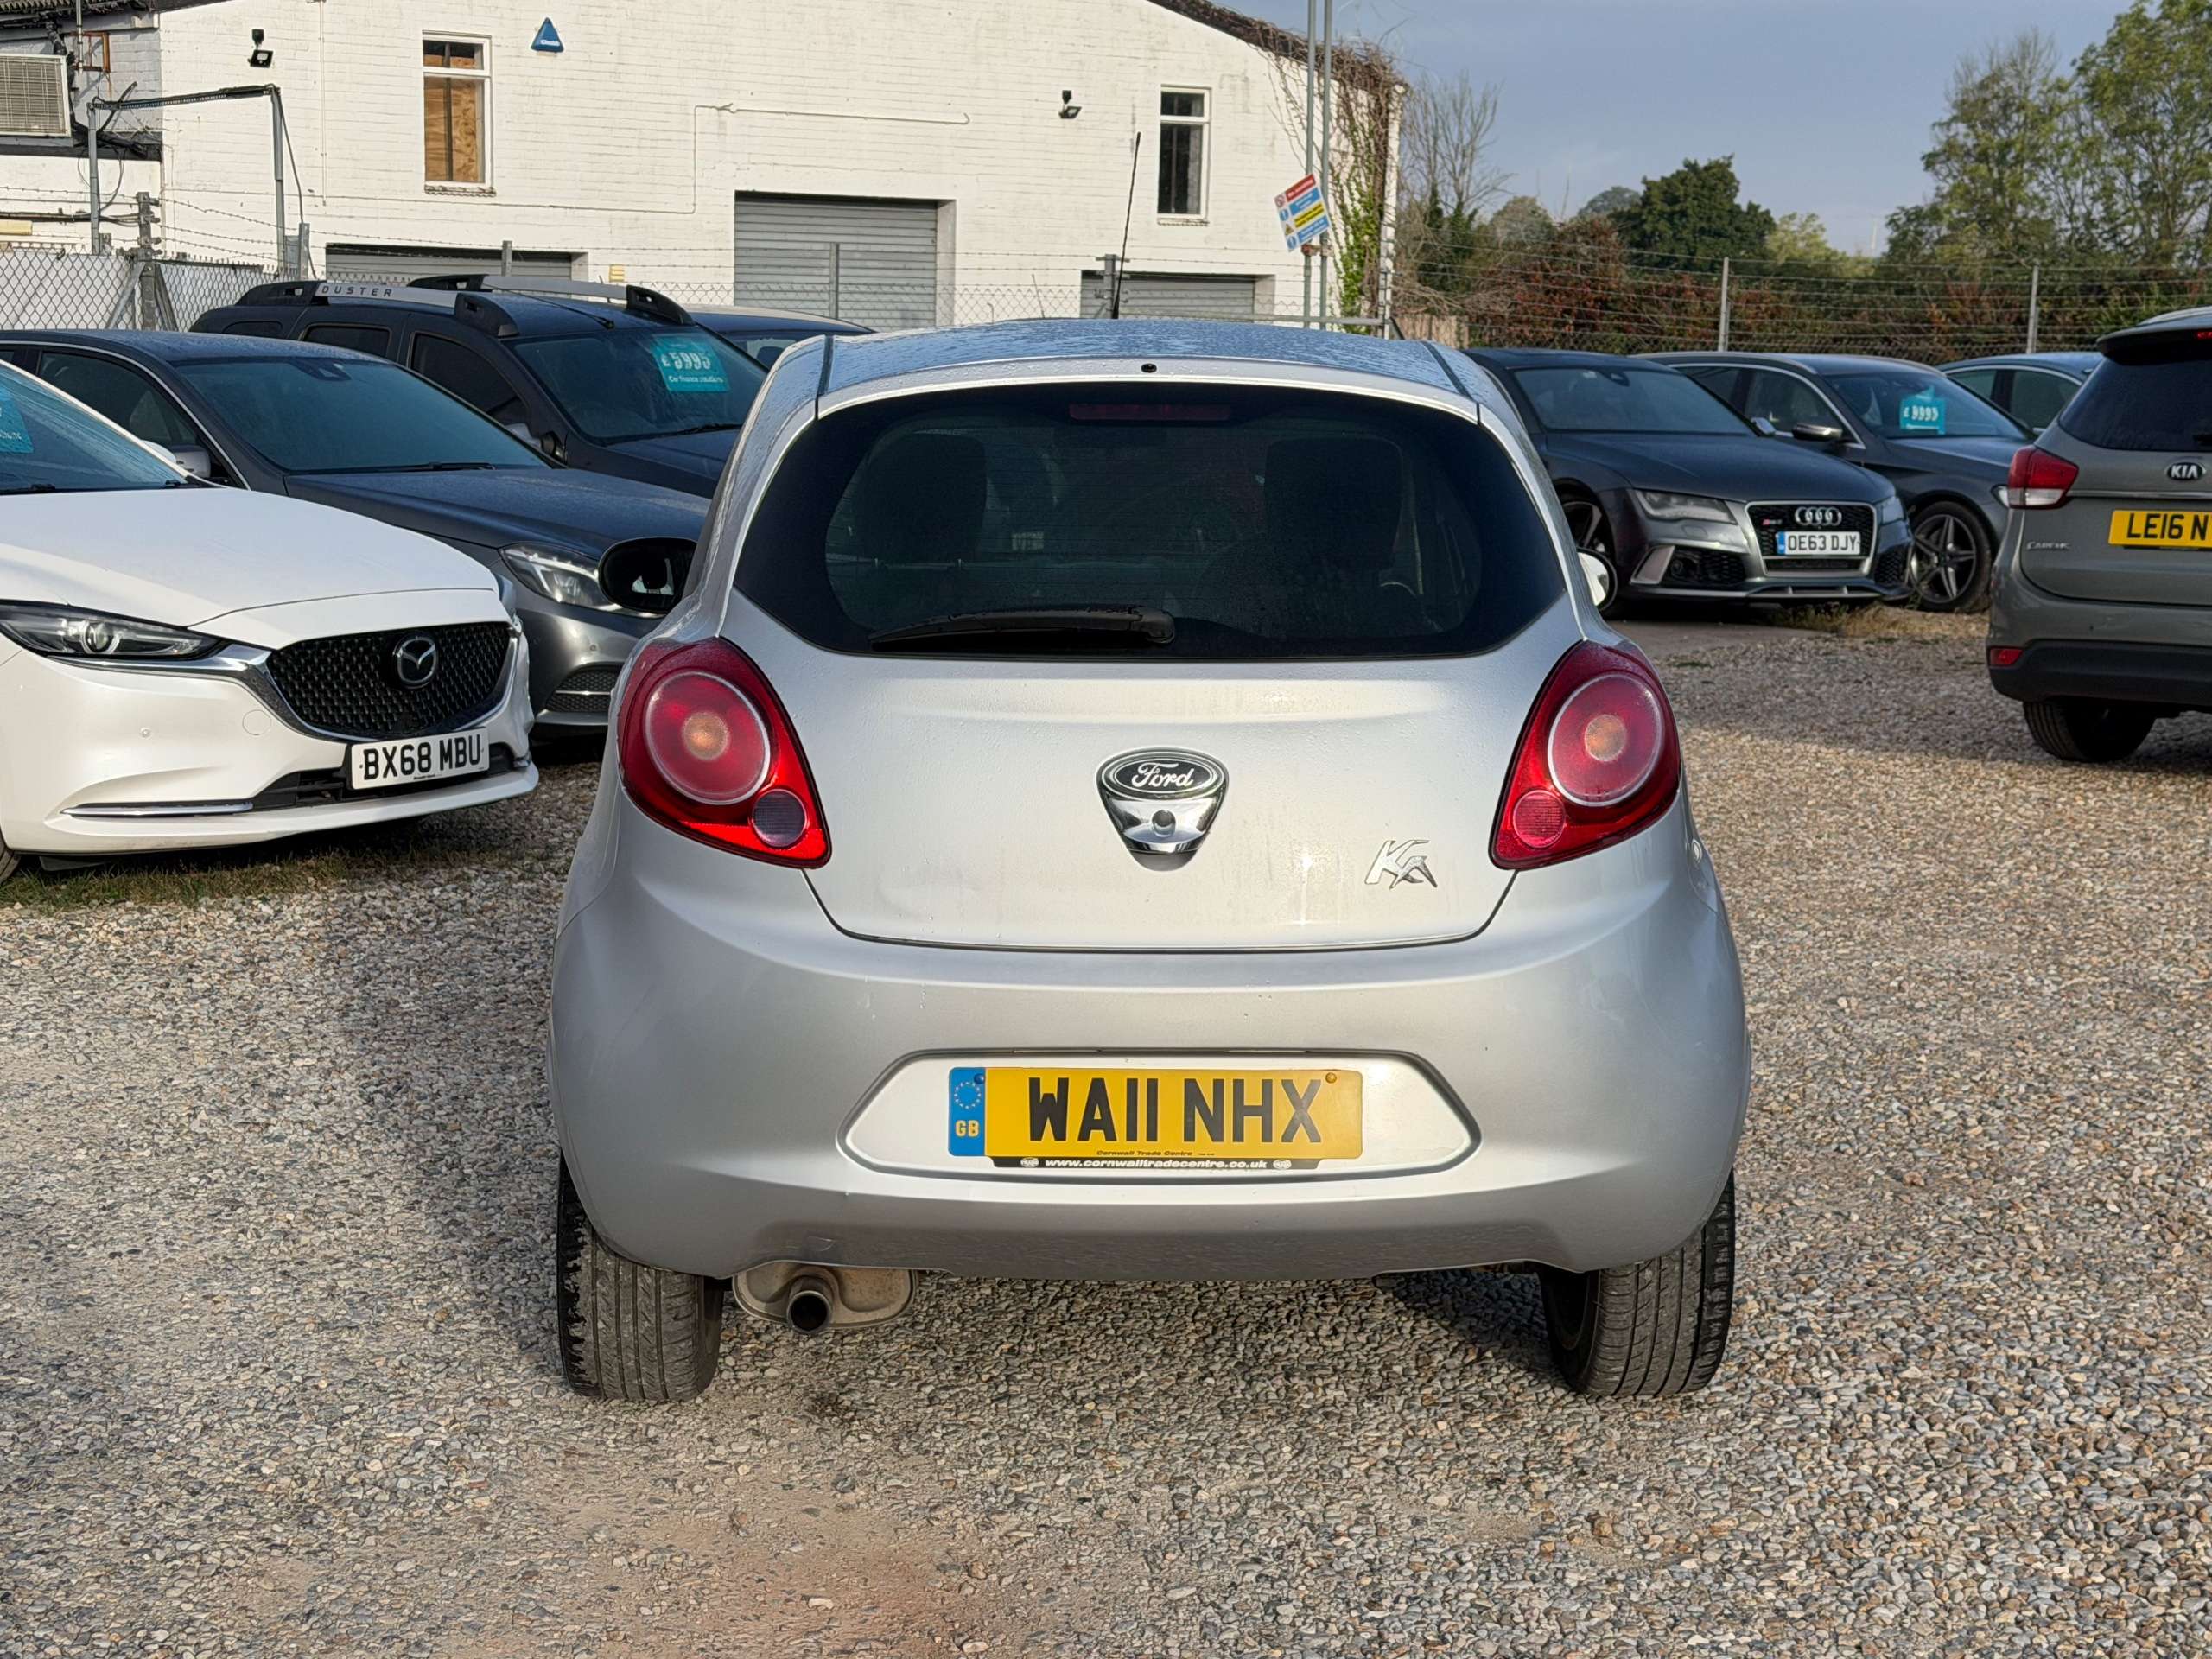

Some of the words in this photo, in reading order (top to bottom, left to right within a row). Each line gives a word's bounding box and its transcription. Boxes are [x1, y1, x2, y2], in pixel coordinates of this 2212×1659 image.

[321, 285, 393, 297] DUSTER
[2171, 464, 2199, 479] KIA
[2126, 512, 2185, 540] LE16
[2190, 514, 2212, 542] N
[1788, 535, 1827, 551] OE63
[1831, 535, 1857, 550] DJY
[363, 741, 432, 781] BX68
[439, 734, 481, 771] MBU
[1131, 762, 1195, 788] Ford
[1028, 1077, 1159, 1142] WA11
[1183, 1077, 1323, 1143] NHX
[955, 1120, 980, 1137] GB
[1045, 1158, 1268, 1170] www.cornwalltradecentre.co.uk
